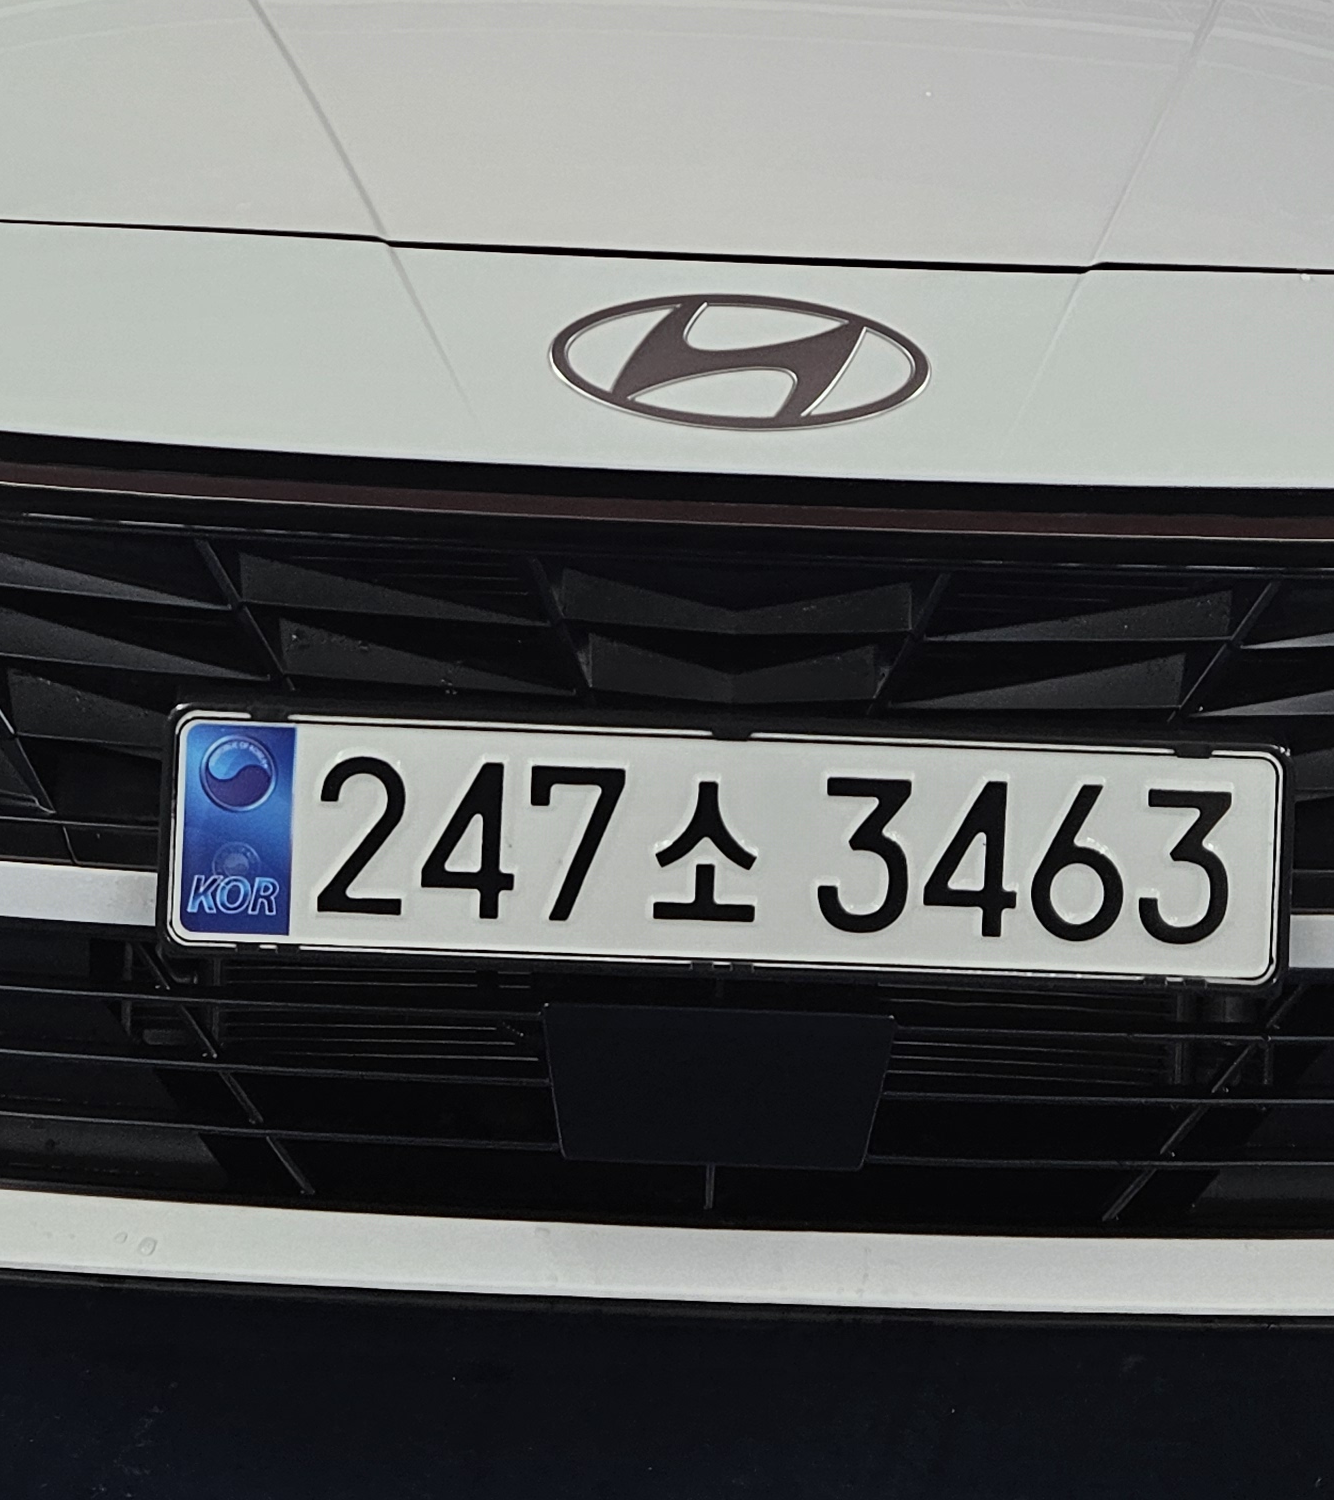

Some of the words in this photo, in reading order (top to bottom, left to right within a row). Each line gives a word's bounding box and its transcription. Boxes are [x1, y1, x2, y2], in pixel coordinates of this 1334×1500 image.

[186, 874, 280, 916] KOR
[316, 756, 757, 923] 247소
[817, 776, 1232, 945] 3463
